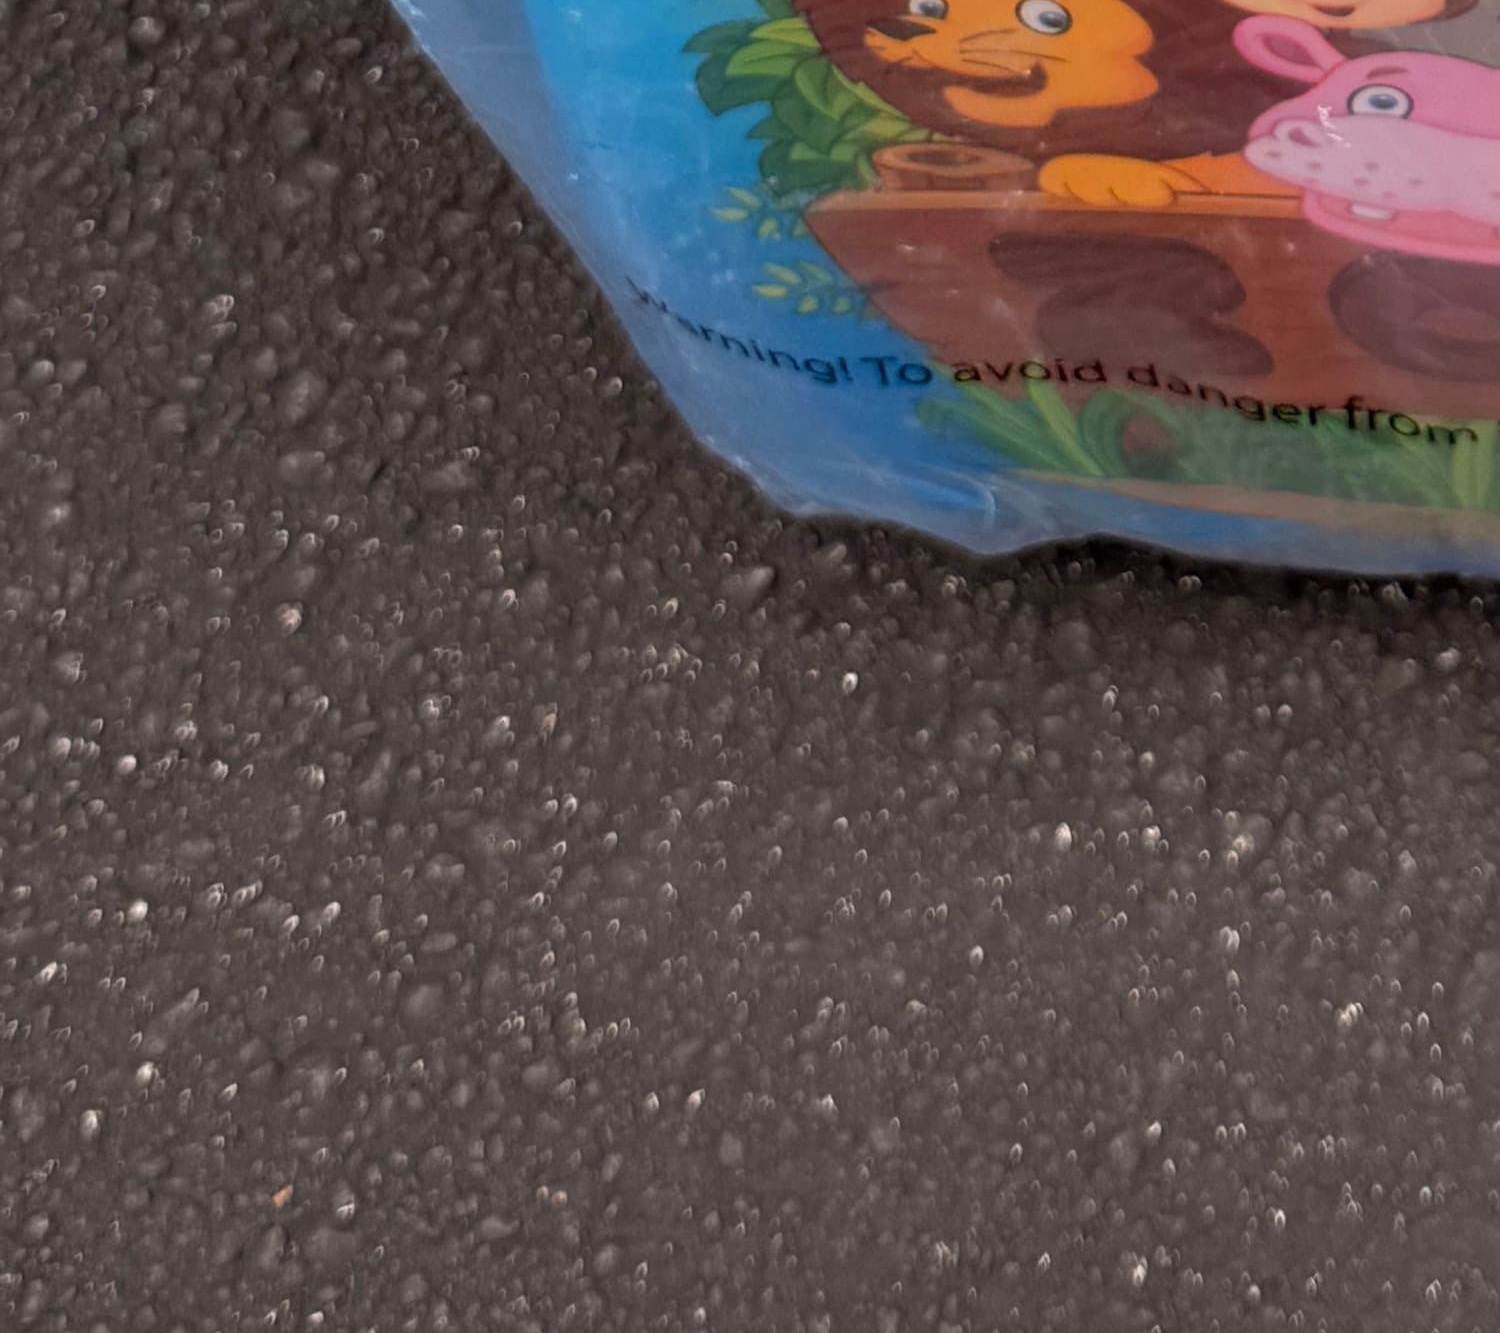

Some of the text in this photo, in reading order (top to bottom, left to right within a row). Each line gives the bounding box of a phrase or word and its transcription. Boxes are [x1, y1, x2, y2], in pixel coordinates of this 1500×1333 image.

[860, 355, 933, 387] To
[953, 358, 1108, 384] avoid
[1127, 363, 1327, 429] danger
[1344, 395, 1480, 446] from
